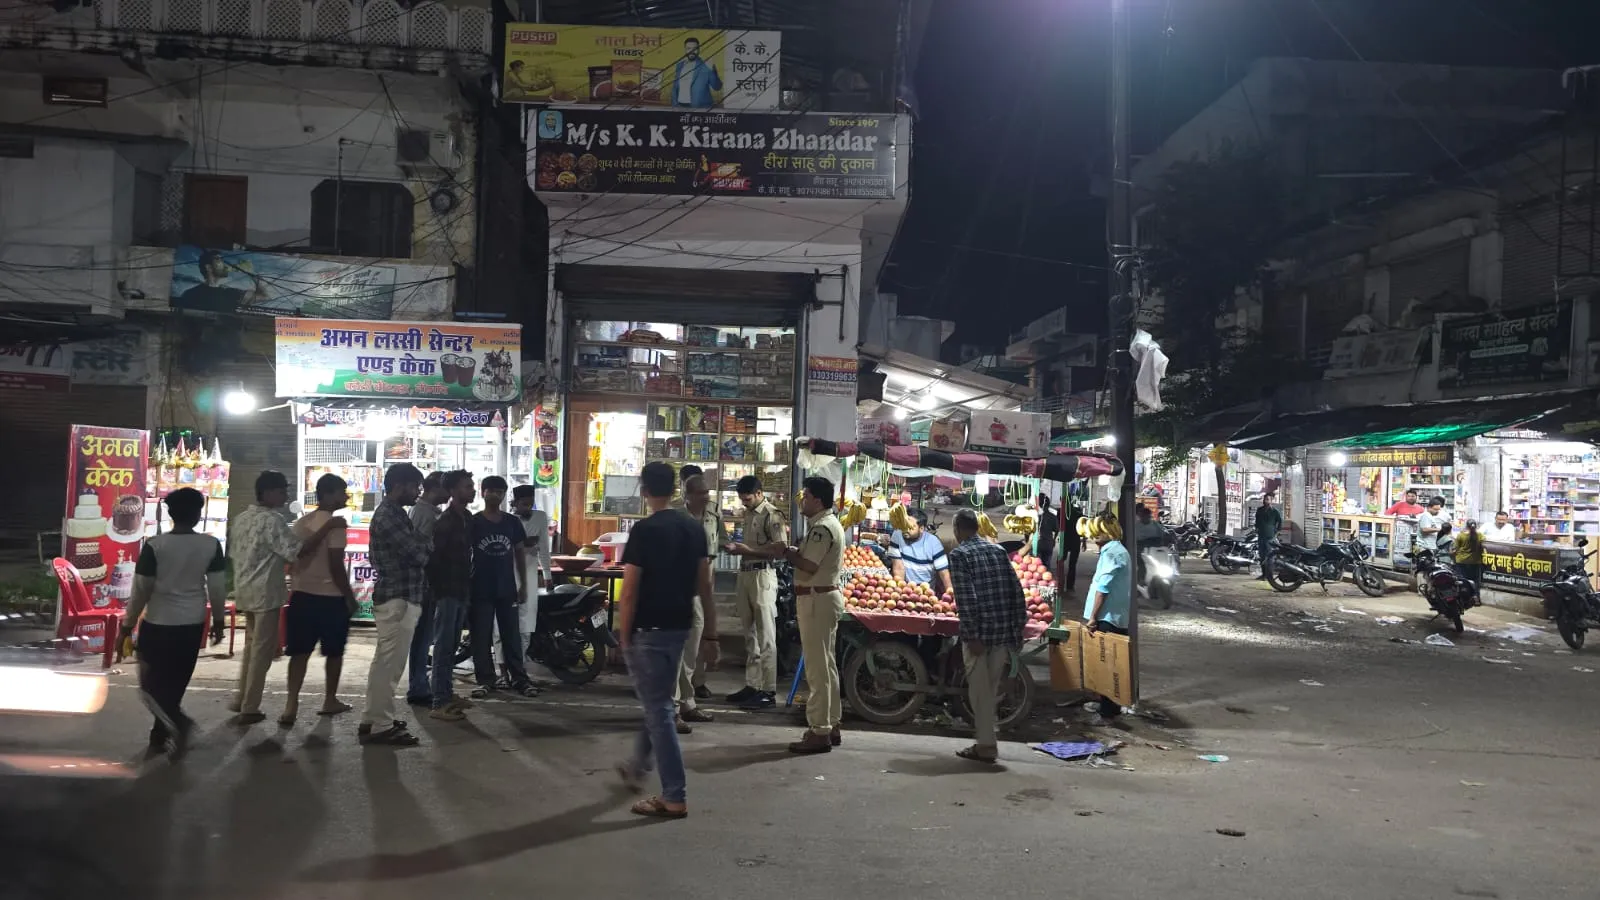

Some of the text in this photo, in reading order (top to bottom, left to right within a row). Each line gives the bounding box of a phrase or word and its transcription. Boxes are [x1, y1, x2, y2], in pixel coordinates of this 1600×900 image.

[511, 30, 556, 43] PUSHP
[595, 36, 627, 47] लाल
[735, 40, 771, 57] के. के.
[732, 58, 773, 74] किराना
[736, 77, 768, 92] स्टोर्स
[828, 117, 880, 128] Since 1967
[566, 122, 879, 152] M/s K. K. Kirana Bhandar
[763, 150, 877, 174] हीरा साहू की दुकान
[1483, 317, 1528, 337] साहित्य
[1529, 312, 1559, 332] सदन
[320, 327, 475, 353] अमन लस्सी सेन्टर
[357, 352, 437, 376] एण्ड केक
[81, 434, 141, 458] अमन
[84, 458, 136, 488] केक
[1496, 554, 1512, 573] साहू
[1513, 552, 1525, 571] की
[1526, 558, 1552, 577] दुकान
